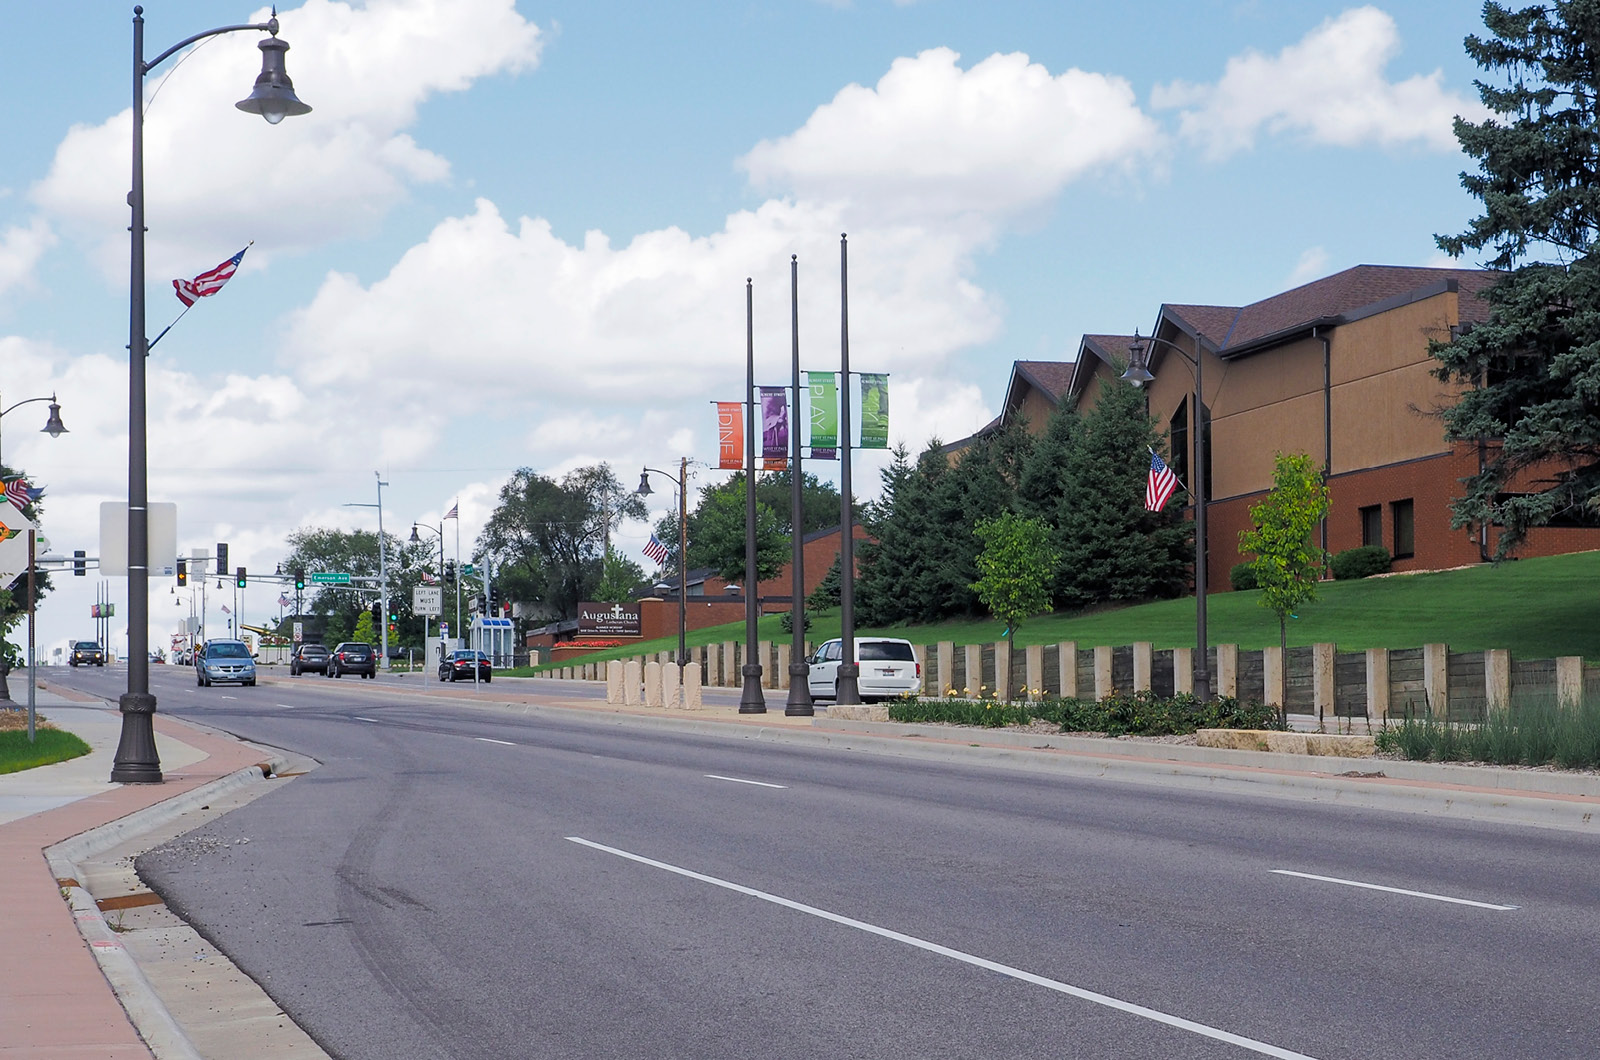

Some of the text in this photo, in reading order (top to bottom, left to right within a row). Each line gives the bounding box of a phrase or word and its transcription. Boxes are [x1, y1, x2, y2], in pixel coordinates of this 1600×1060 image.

[809, 385, 826, 430] PLAY
[719, 413, 734, 455] DINE
[581, 604, 639, 623] Augustana
